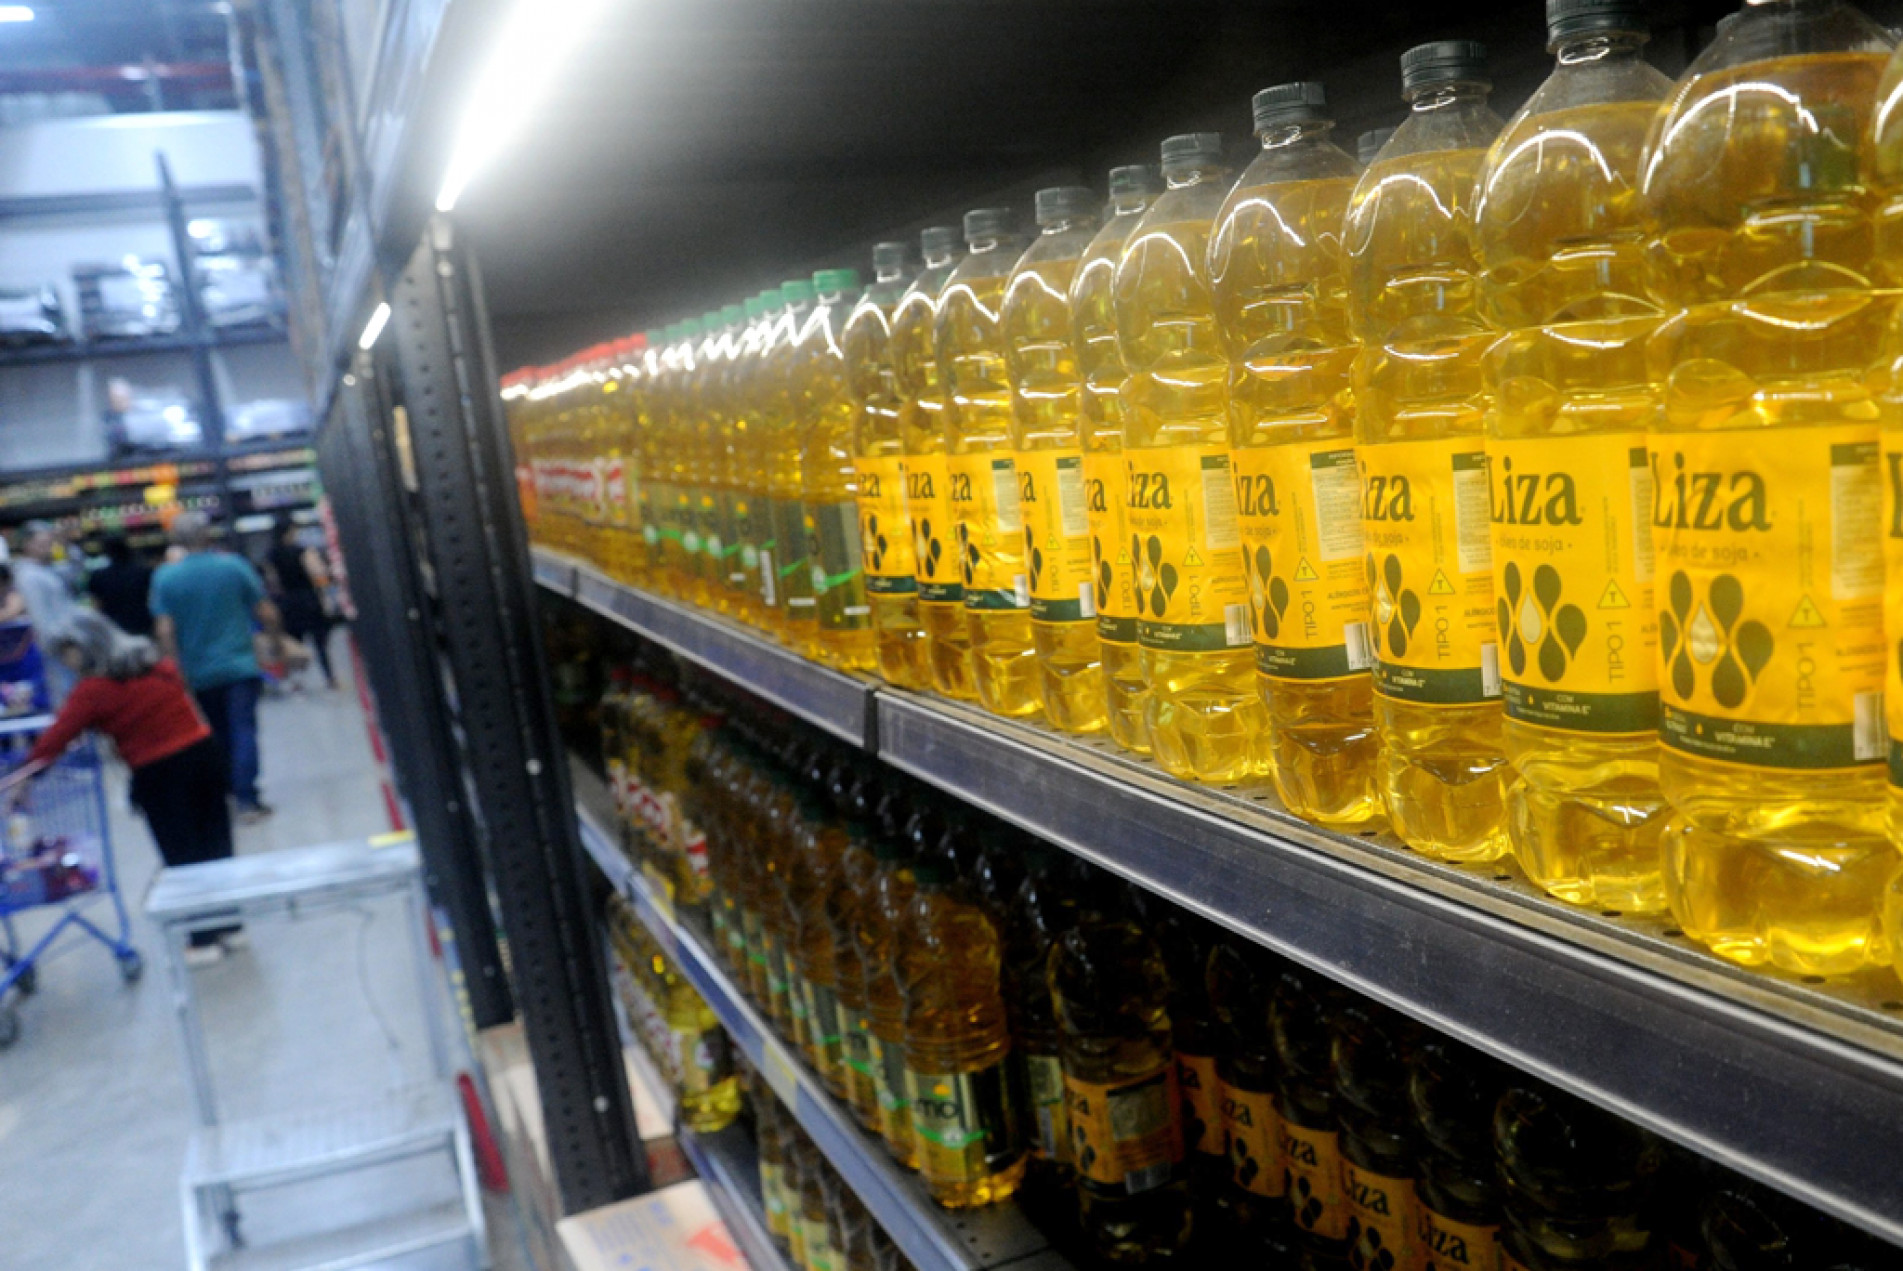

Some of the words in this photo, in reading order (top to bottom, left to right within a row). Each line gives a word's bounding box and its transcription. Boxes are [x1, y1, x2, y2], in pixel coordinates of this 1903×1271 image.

[1486, 455, 1583, 526] Liza
[1650, 451, 1772, 532] Liza
[1711, 542, 1748, 566] soja
[1302, 600, 1319, 640] TIPO
[1435, 616, 1451, 660] TIPO
[1607, 634, 1625, 684] TIPO
